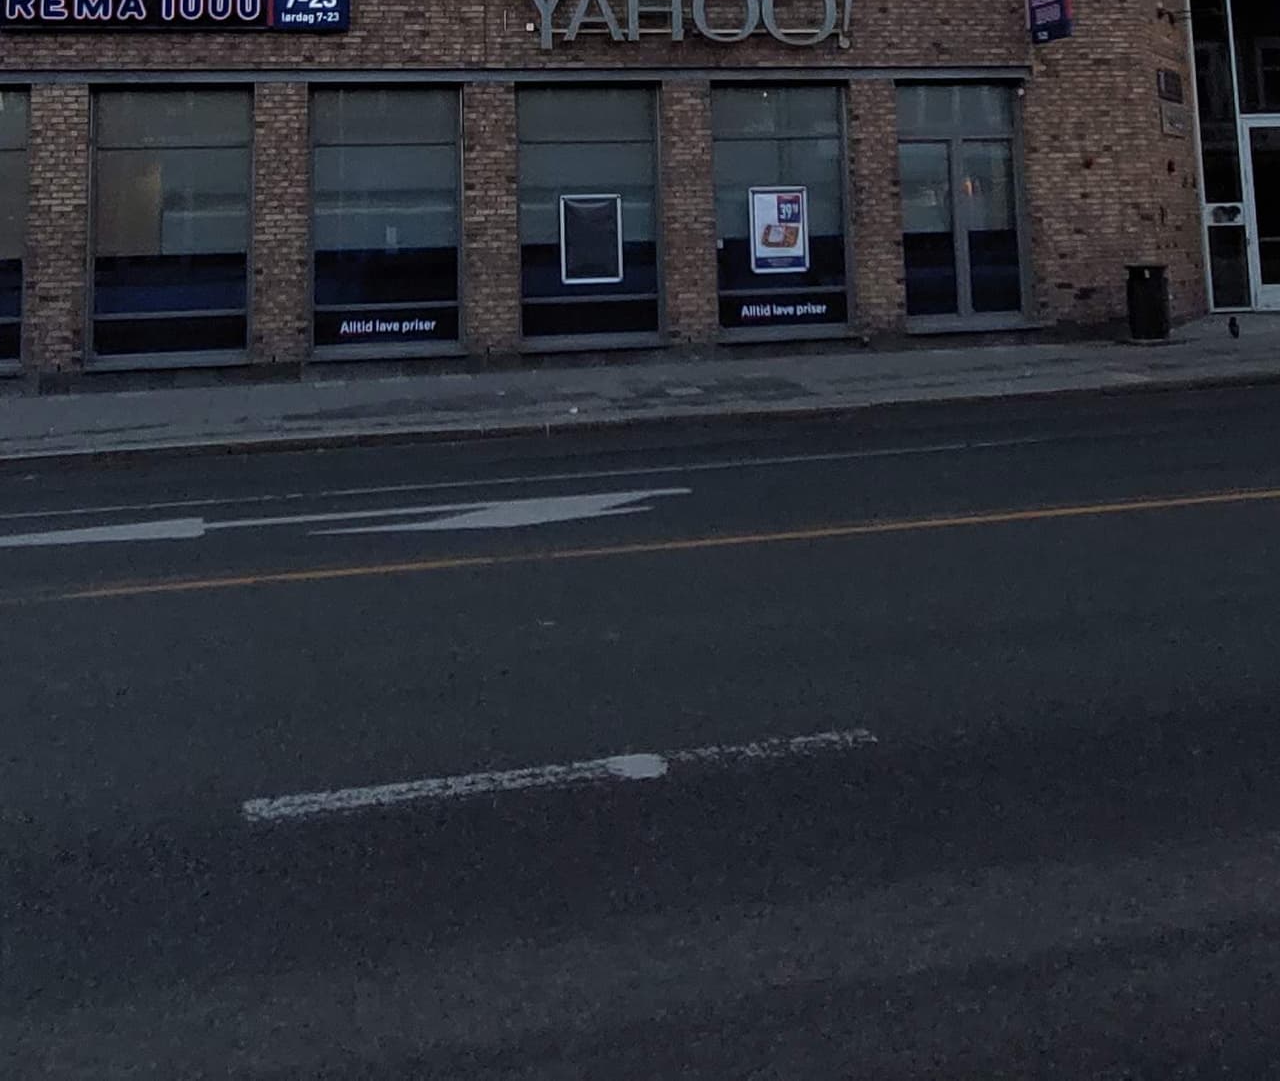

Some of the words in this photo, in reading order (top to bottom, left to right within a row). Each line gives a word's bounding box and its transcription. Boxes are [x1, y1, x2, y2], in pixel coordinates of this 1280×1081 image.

[741, 303, 771, 319] Alltid
[772, 303, 795, 316] lave
[796, 302, 827, 316] priser
[340, 319, 373, 334] Alltid
[375, 319, 400, 332] lave
[402, 318, 436, 333] priser
